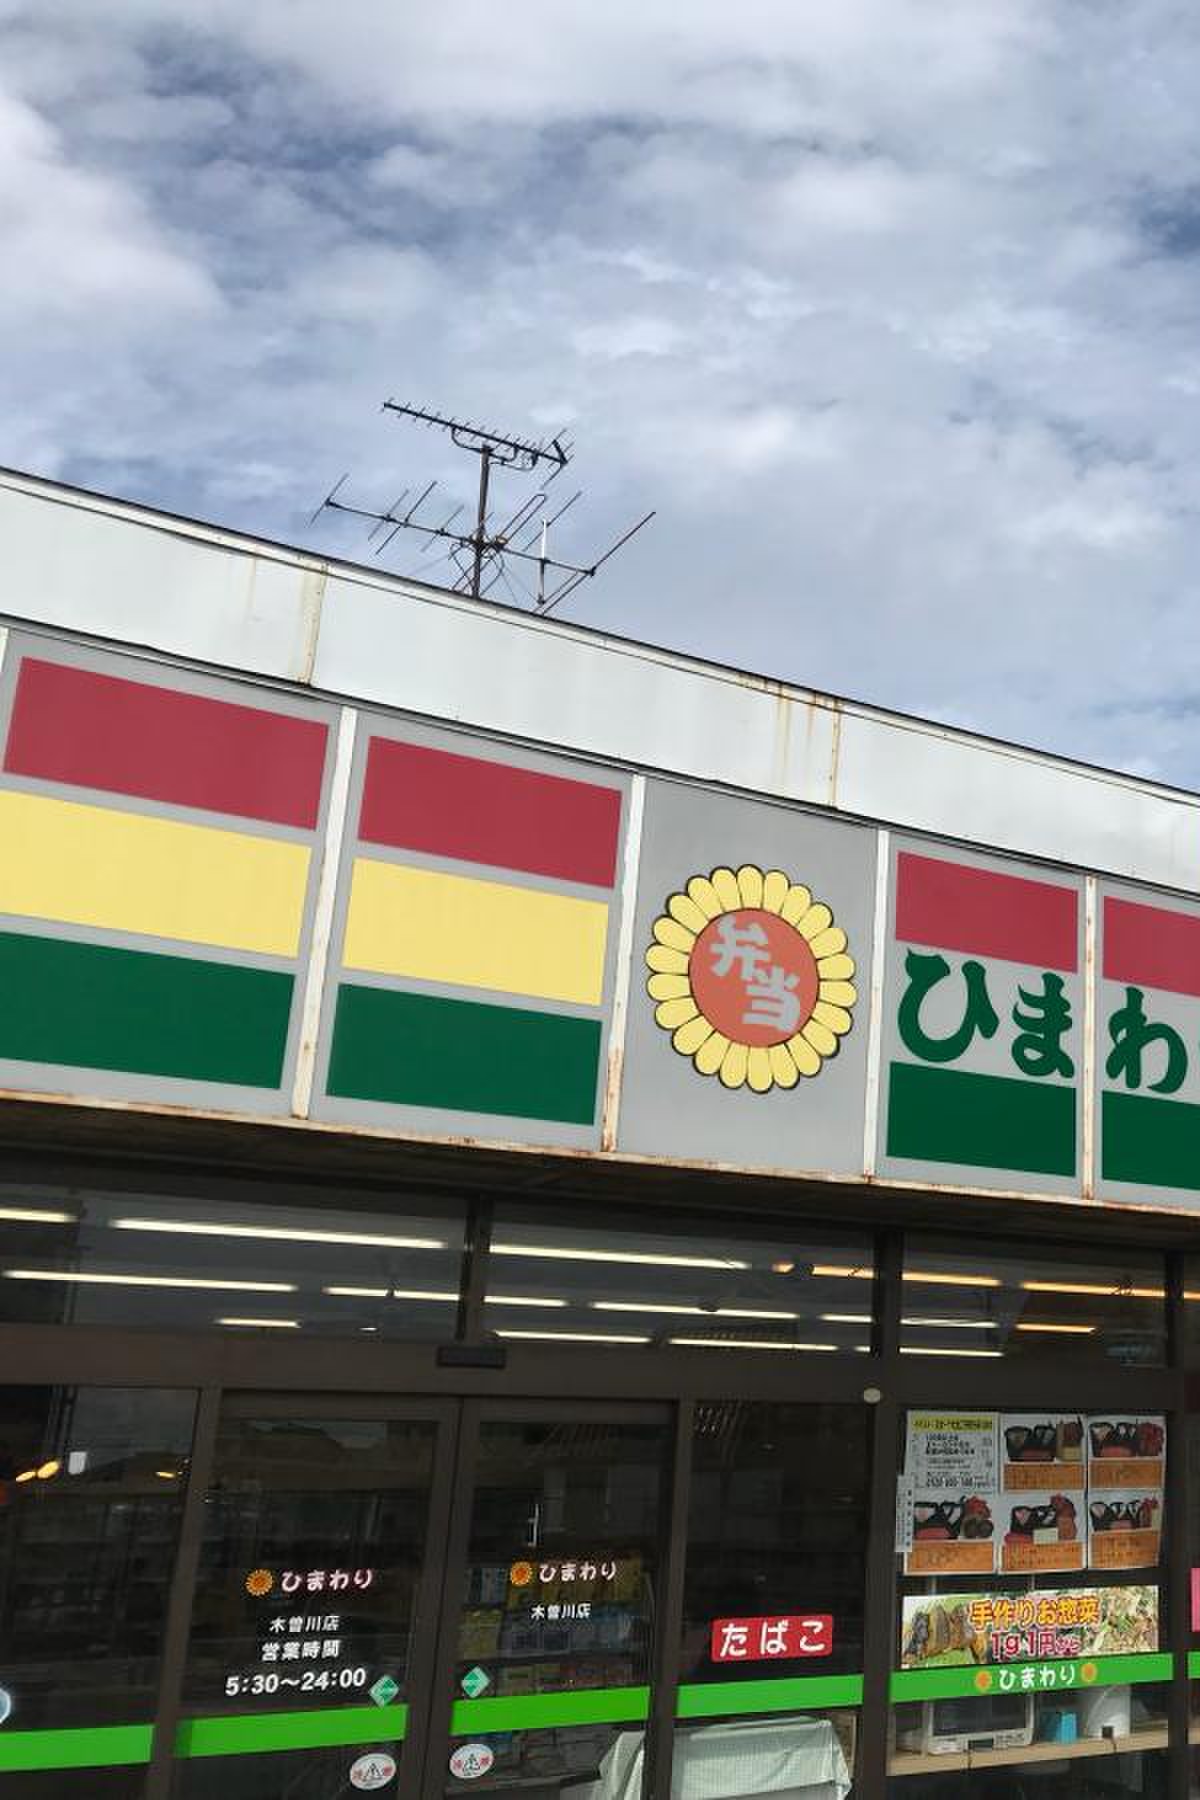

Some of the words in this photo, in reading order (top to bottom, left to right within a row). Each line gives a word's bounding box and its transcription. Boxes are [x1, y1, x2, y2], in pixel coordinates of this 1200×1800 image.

[709, 916, 801, 1032] 弁当
[280, 1567, 374, 1592] ひまわり
[538, 1561, 618, 1583] ひまわり
[968, 1596, 1101, 1634] 手作りお惣菜
[261, 1640, 341, 1663] 営業時間
[719, 1619, 828, 1658] たばこ
[999, 1664, 1077, 1691] ひまわり
